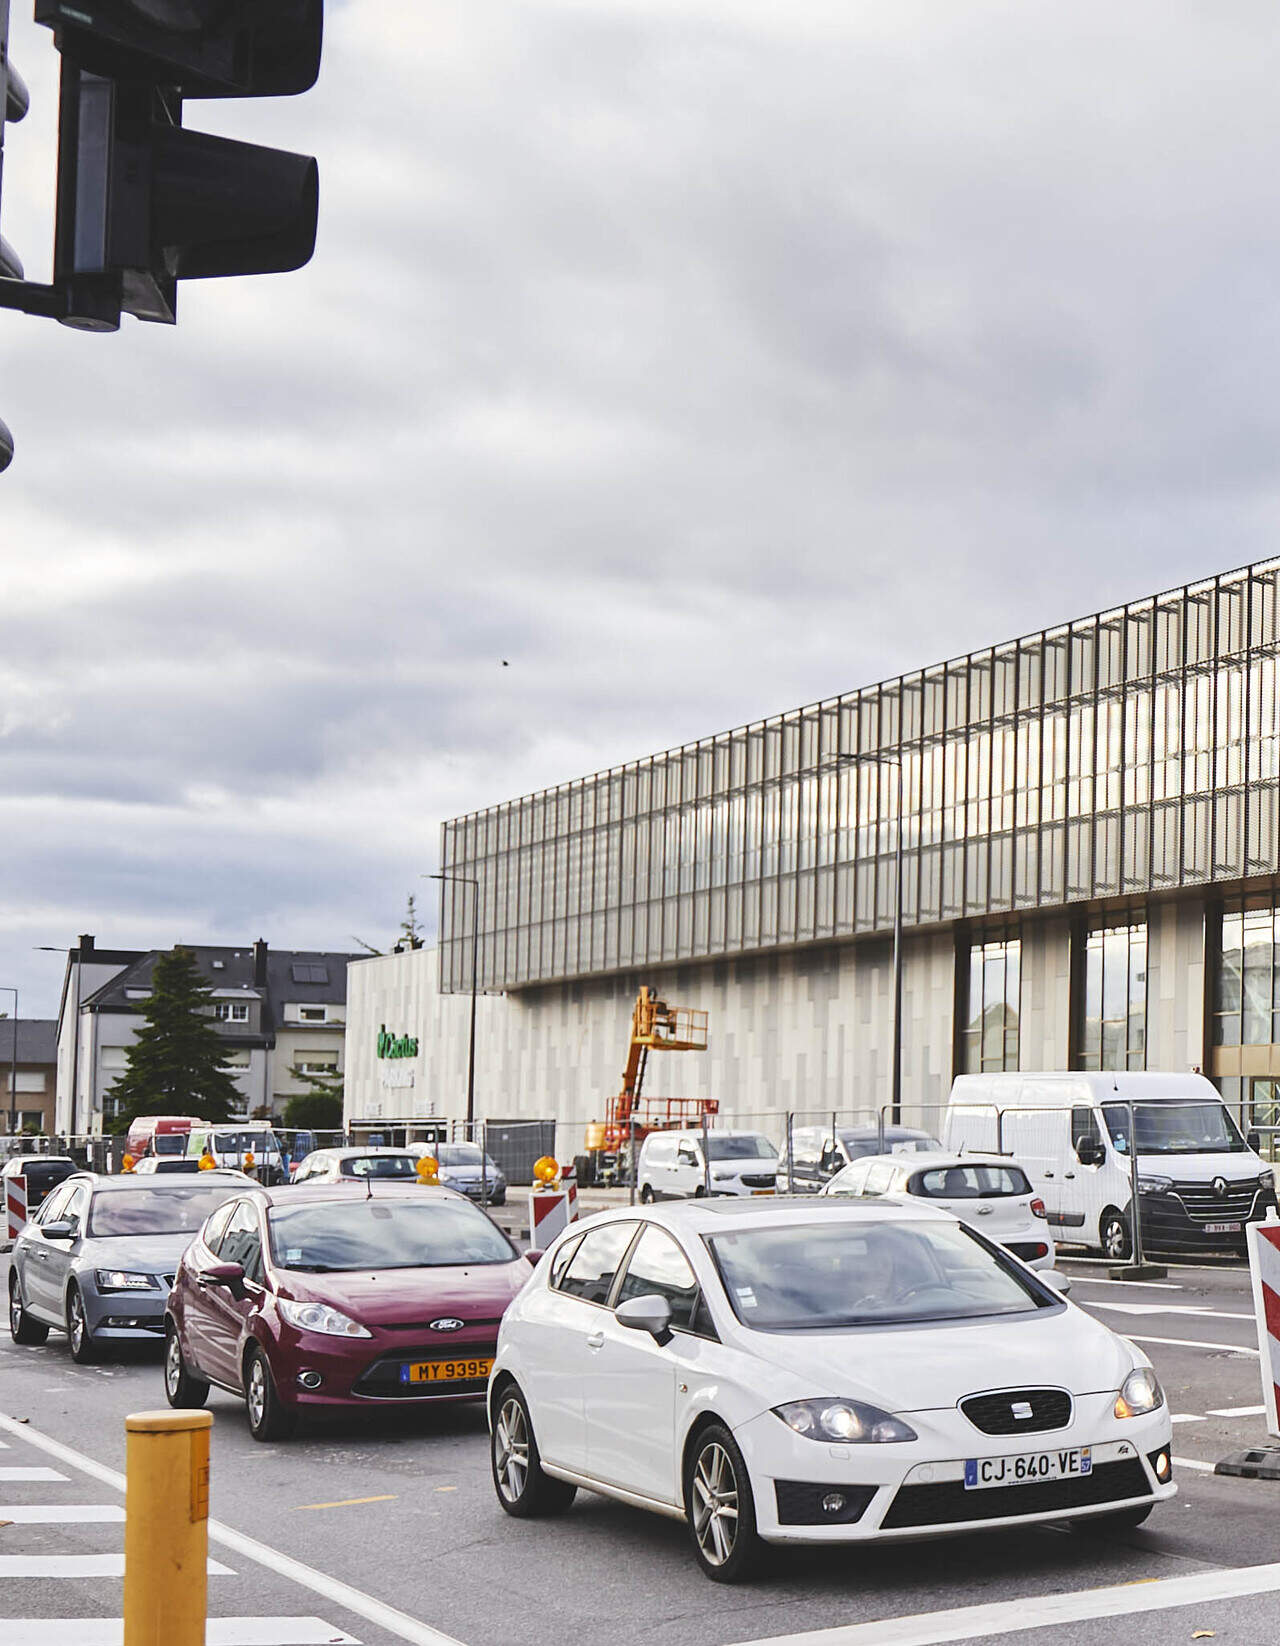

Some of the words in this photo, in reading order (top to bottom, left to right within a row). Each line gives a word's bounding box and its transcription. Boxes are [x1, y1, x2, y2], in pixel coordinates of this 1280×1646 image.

[418, 1364, 440, 1380] MY
[445, 1360, 489, 1378] 9395
[981, 1451, 1079, 1482] CJ-640-VE
